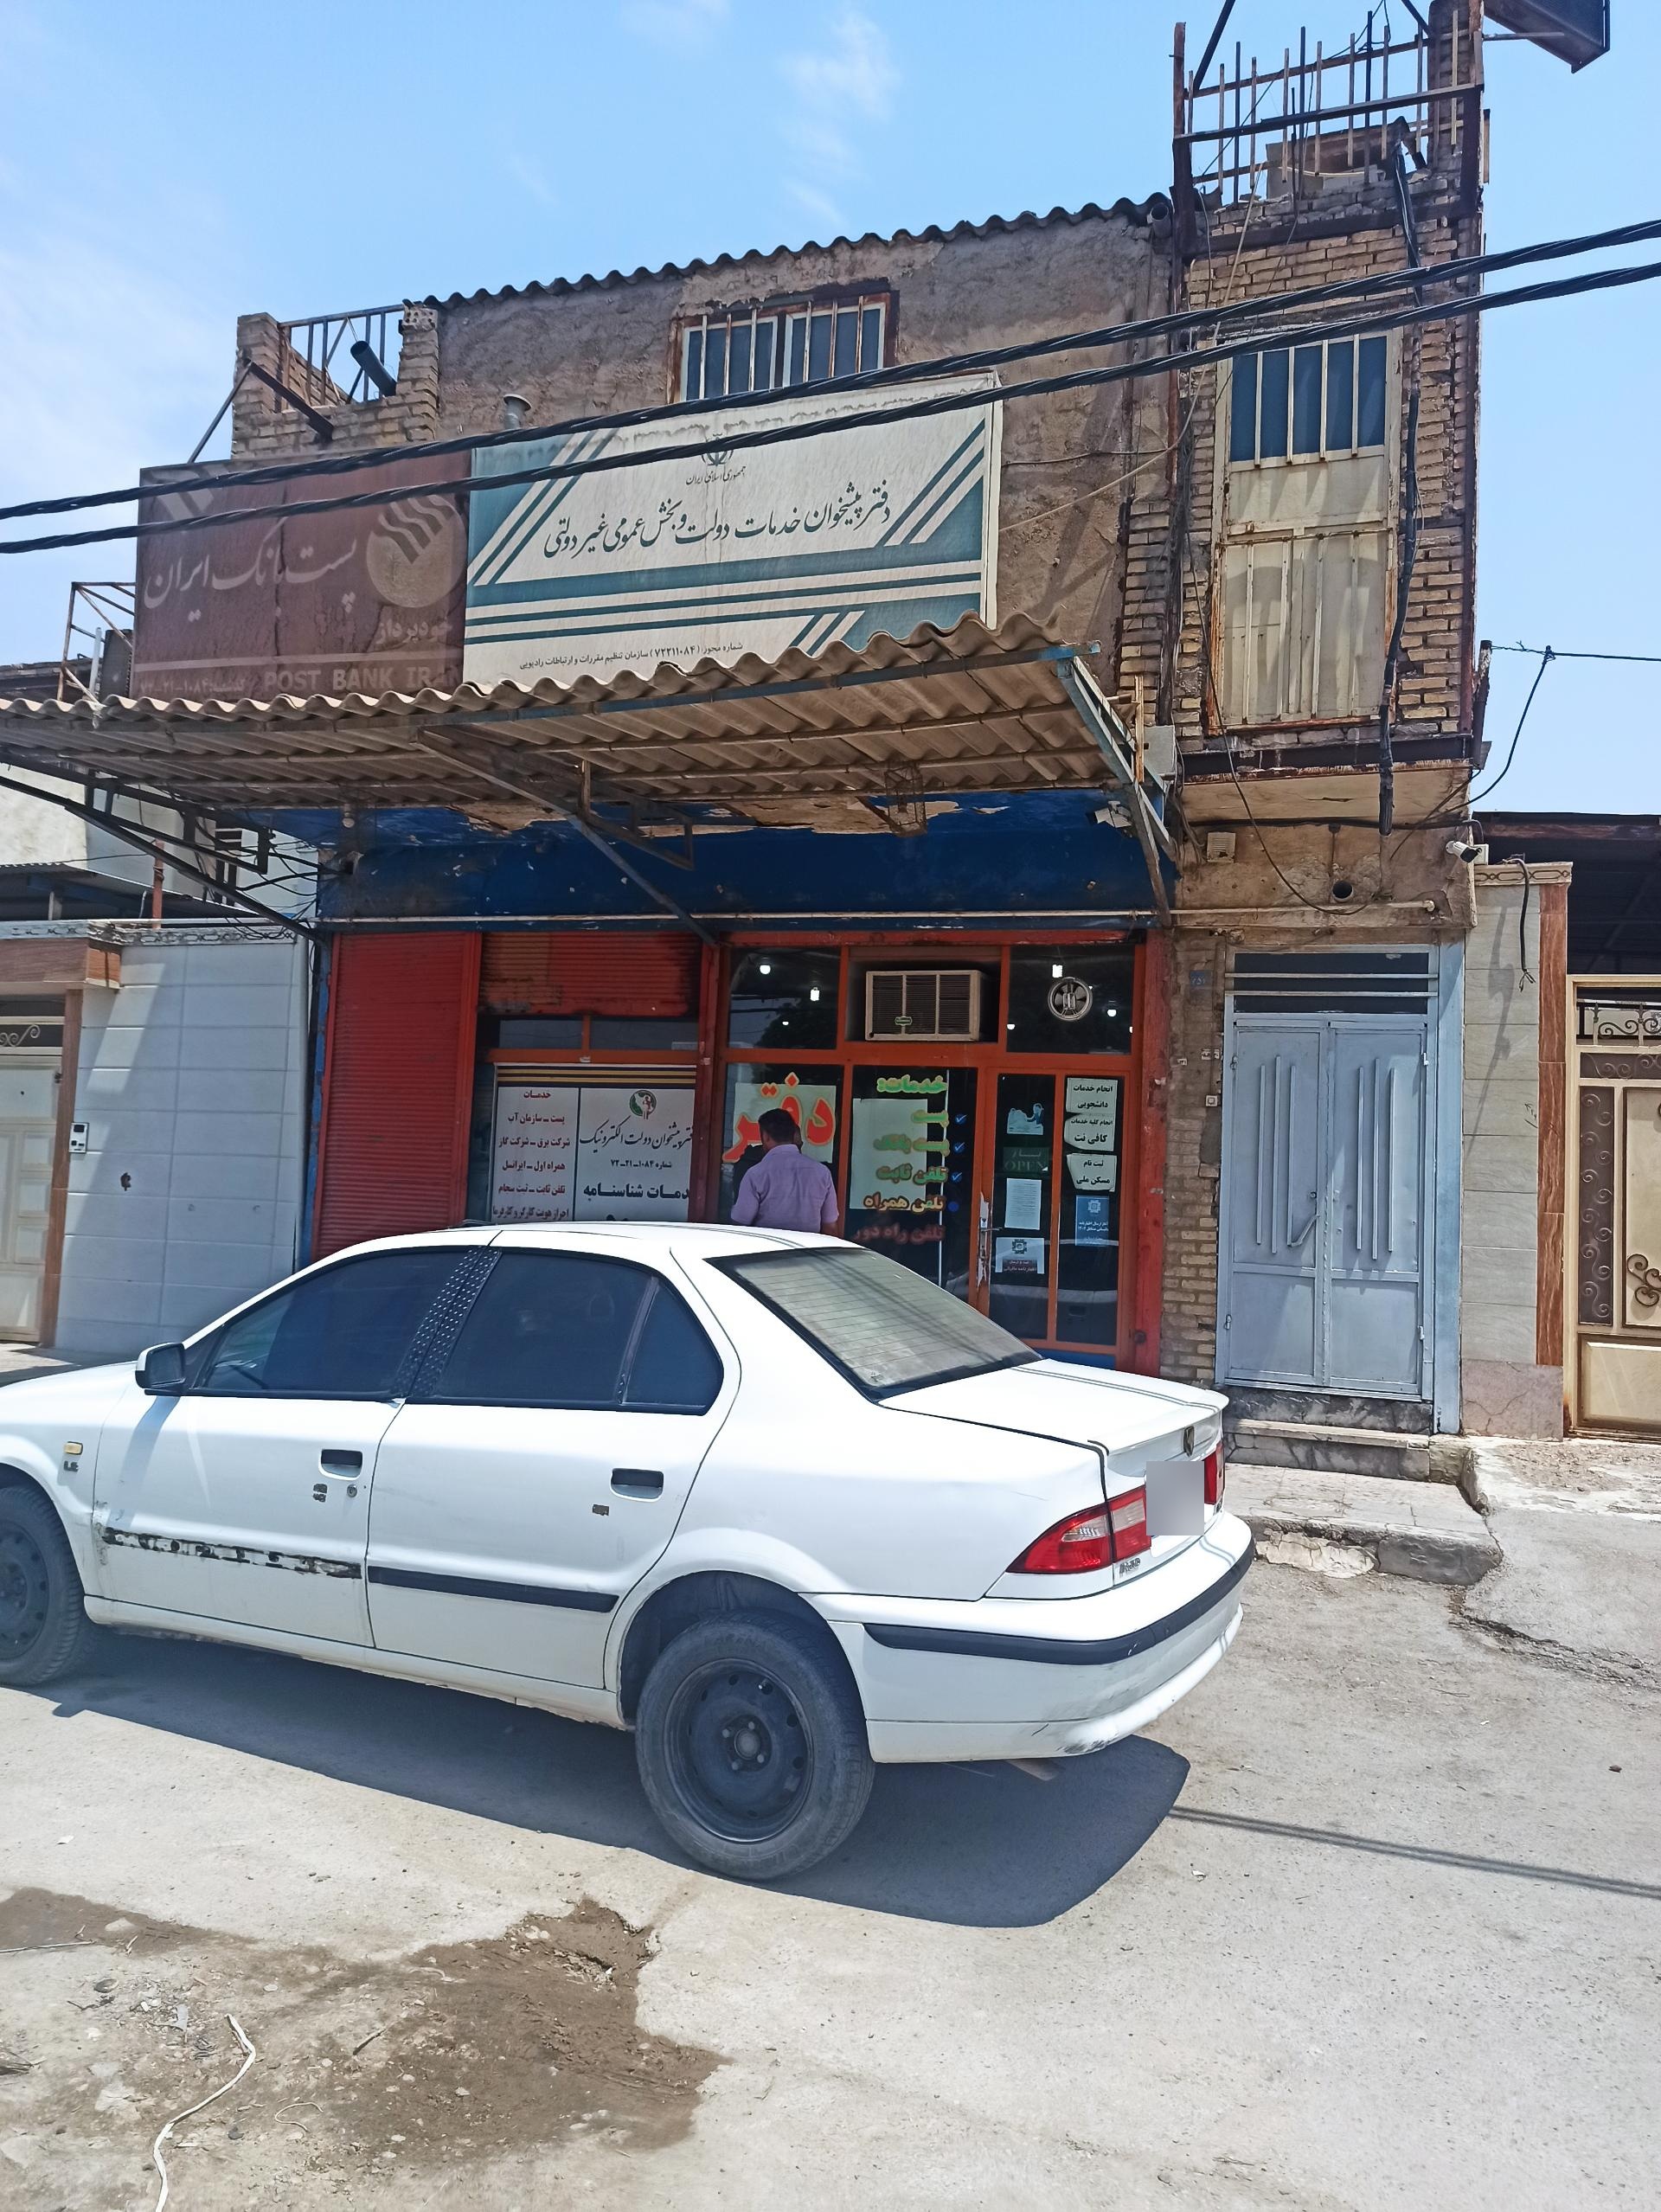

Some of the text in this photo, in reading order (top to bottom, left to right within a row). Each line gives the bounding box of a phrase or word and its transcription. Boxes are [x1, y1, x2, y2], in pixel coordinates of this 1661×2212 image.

[686, 466, 746, 485] جمهوری اسلامی ایران
[805, 482, 862, 532] پیشخوان
[853, 479, 890, 530] دفتر
[640, 498, 683, 547] بخش
[675, 508, 729, 544] دولت
[734, 507, 801, 538] خدمات
[543, 516, 578, 558] دولتی
[571, 513, 608, 558] غیر
[603, 517, 645, 552] عمومی
[144, 516, 356, 622] پست بانک ایران
[722, 642, 743, 652] شماره
[545, 656, 573, 666] ارتباطات
[579, 654, 604, 664] مقررات
[605, 651, 623, 664] تنظیم
[625, 651, 648, 660] سازمان
[520, 657, 543, 670] رادیویی
[263, 670, 321, 691] POST
[332, 668, 393, 690] BANK
[523, 1090, 551, 1099] خدمات
[1096, 1085, 1113, 1093] انجام
[1077, 1100, 1108, 1110] دانشجویی
[508, 1112, 518, 1123] آب
[520, 1113, 542, 1125] سازمان
[551, 1114, 565, 1125] پست
[911, 1110, 950, 1128] پست
[580, 1115, 631, 1153] الکترونیک
[625, 1132, 651, 1144] دولت
[651, 1122, 682, 1149] پیشخوان
[1074, 1132, 1107, 1144] کافی نت
[510, 1137, 529, 1148] شرکت
[537, 1138, 548, 1148] برق
[551, 1137, 570, 1149] شرکت
[873, 1133, 950, 1157] پست بانک
[502, 1160, 526, 1171] ایرانسل
[533, 1160, 546, 1171] اول
[547, 1161, 565, 1172] همراه
[656, 1161, 672, 1170] شماره
[876, 1163, 948, 1185] تلفن ثابت
[1076, 1176, 1111, 1185] مسکن ملی
[551, 1184, 565, 1196] تلفن
[583, 1182, 644, 1202] شناسنامه
[863, 1191, 947, 1215] تلفن همراه
[853, 1222, 946, 1243] تلفن راه دور
